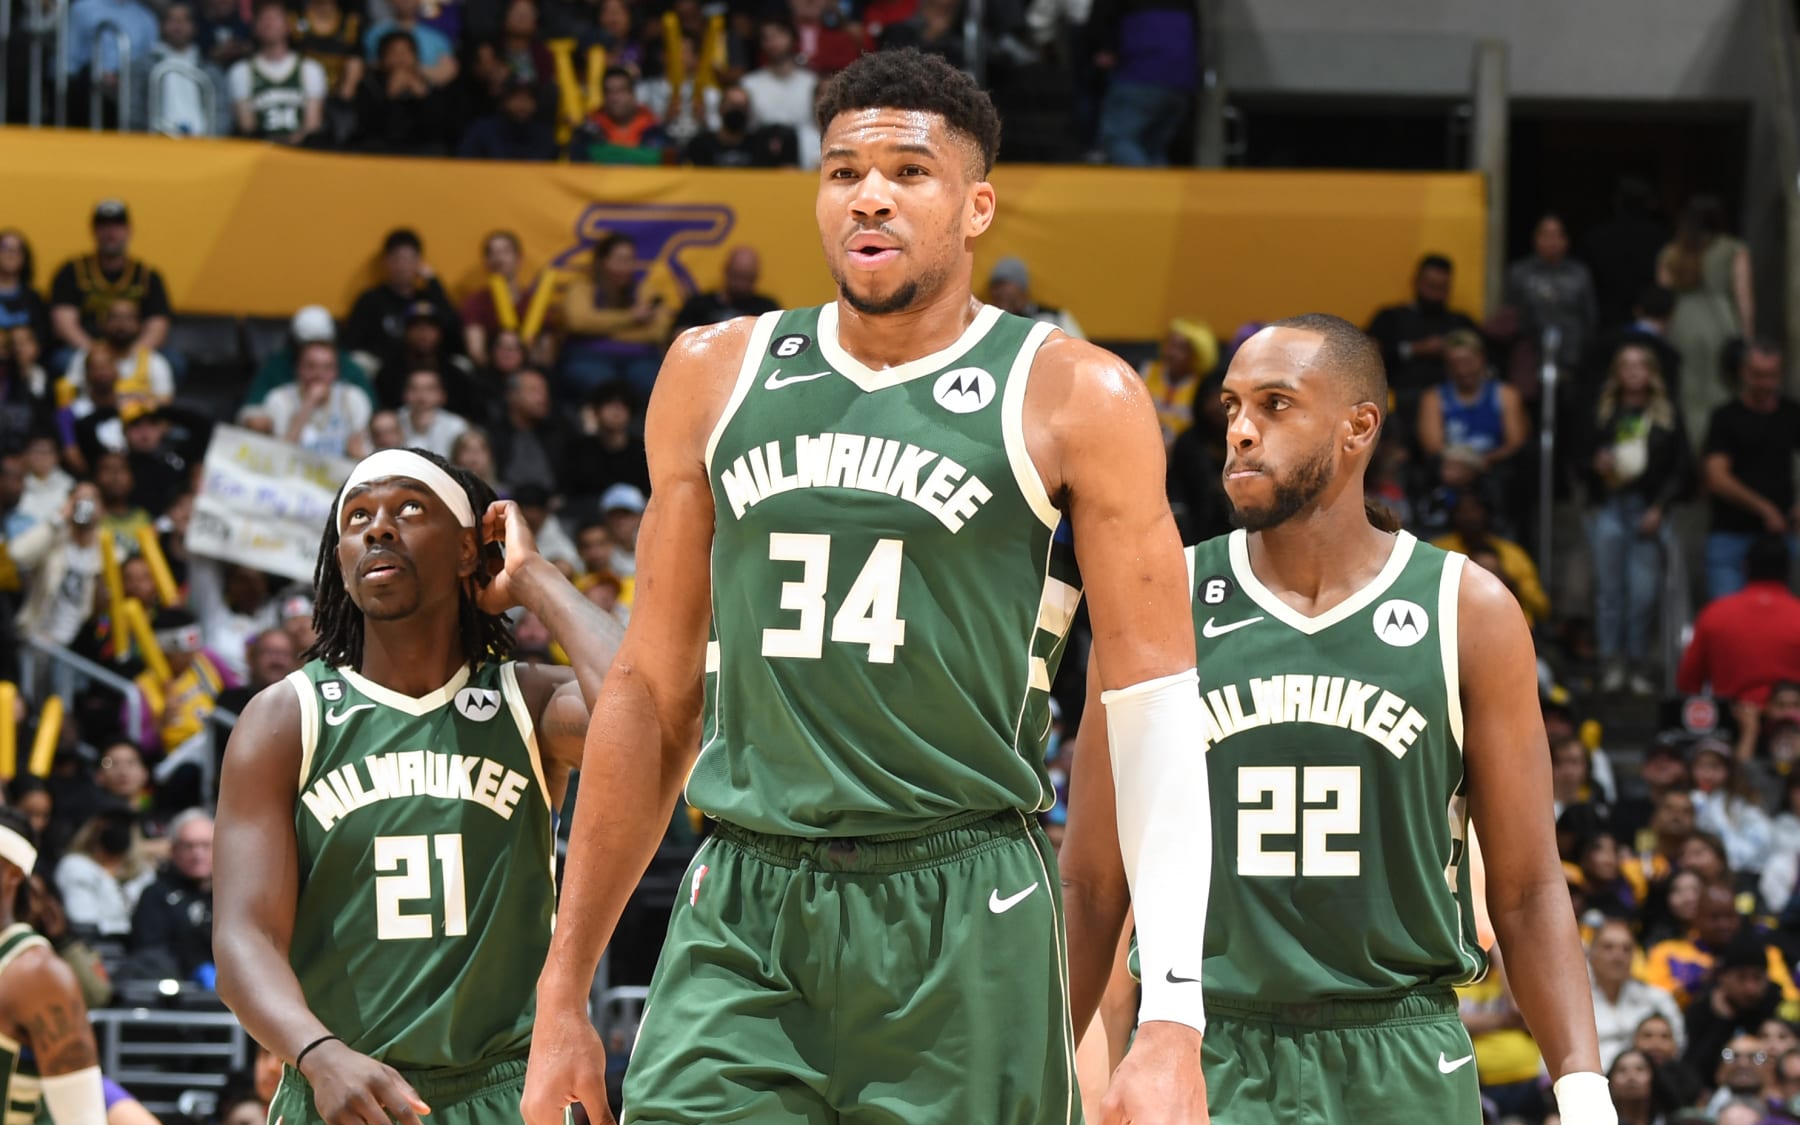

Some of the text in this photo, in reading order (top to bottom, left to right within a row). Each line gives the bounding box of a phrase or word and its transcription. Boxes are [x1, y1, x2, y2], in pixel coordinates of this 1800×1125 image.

[778, 338, 803, 356] 6
[721, 432, 993, 534] MILWAUKEE
[762, 532, 905, 663] 34
[1205, 579, 1226, 604] 6
[321, 682, 342, 700] 6
[302, 750, 529, 832] MILWAUKEE
[1237, 766, 1361, 876] 22
[374, 833, 467, 940] 21
